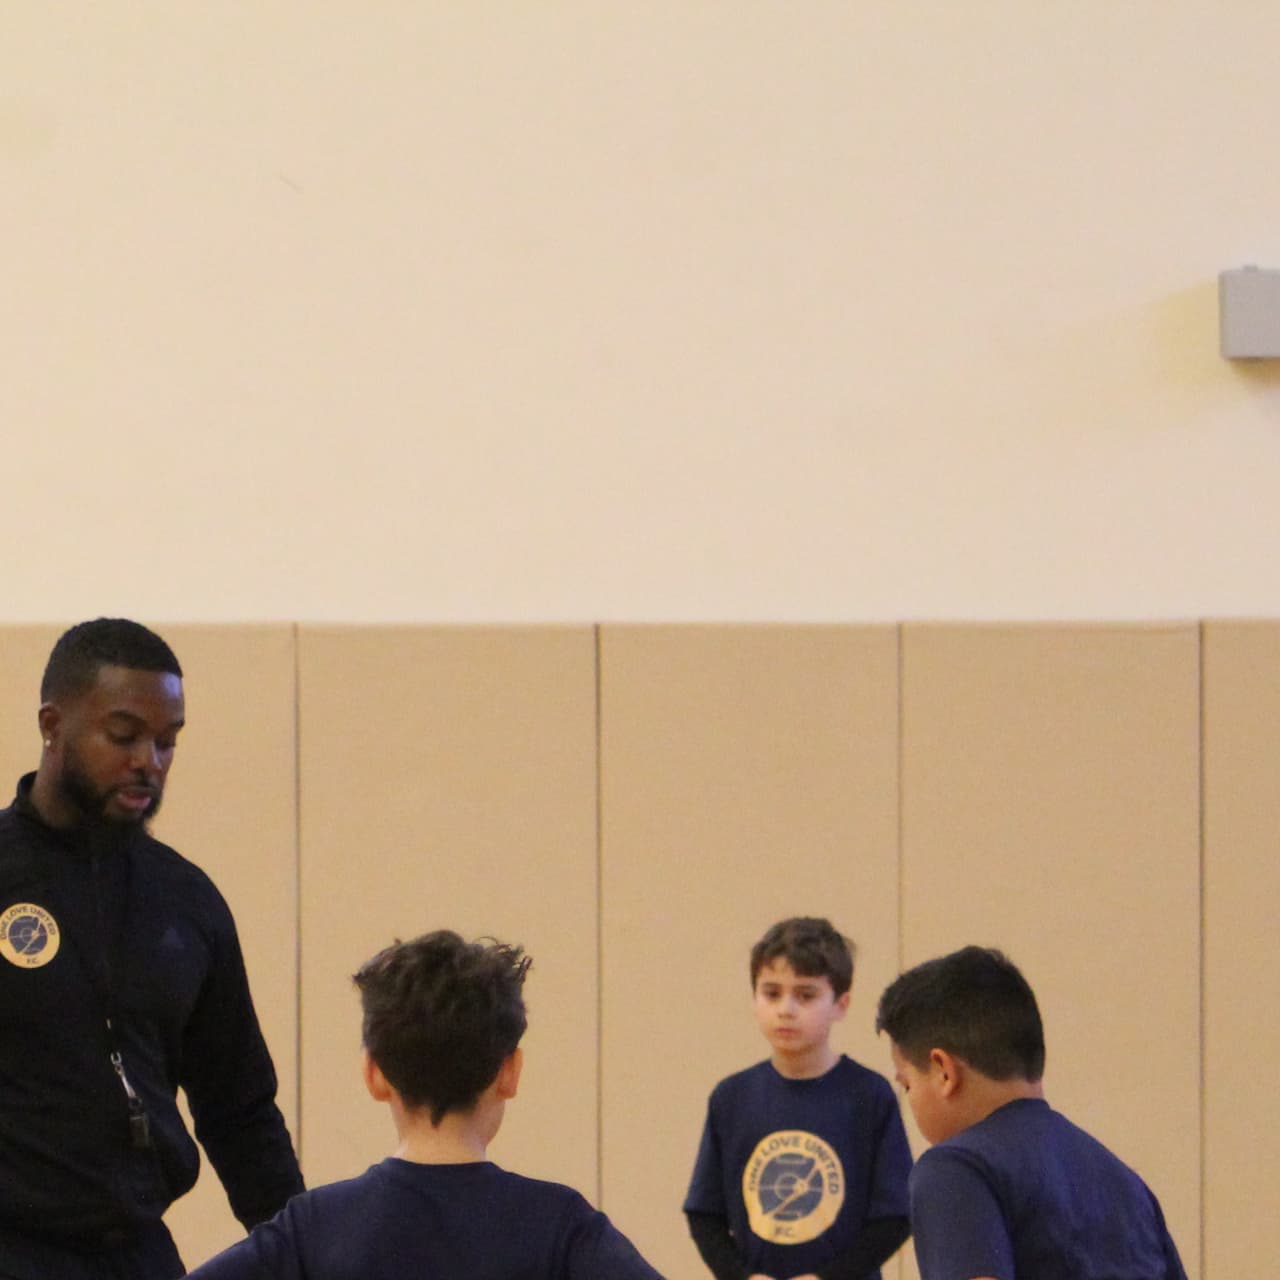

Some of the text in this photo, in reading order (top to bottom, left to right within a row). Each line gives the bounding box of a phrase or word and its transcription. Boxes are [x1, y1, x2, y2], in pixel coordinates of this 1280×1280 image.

[7, 906, 28, 920] LOVE
[749, 1136, 839, 1195] ONE LOVE UNITED
